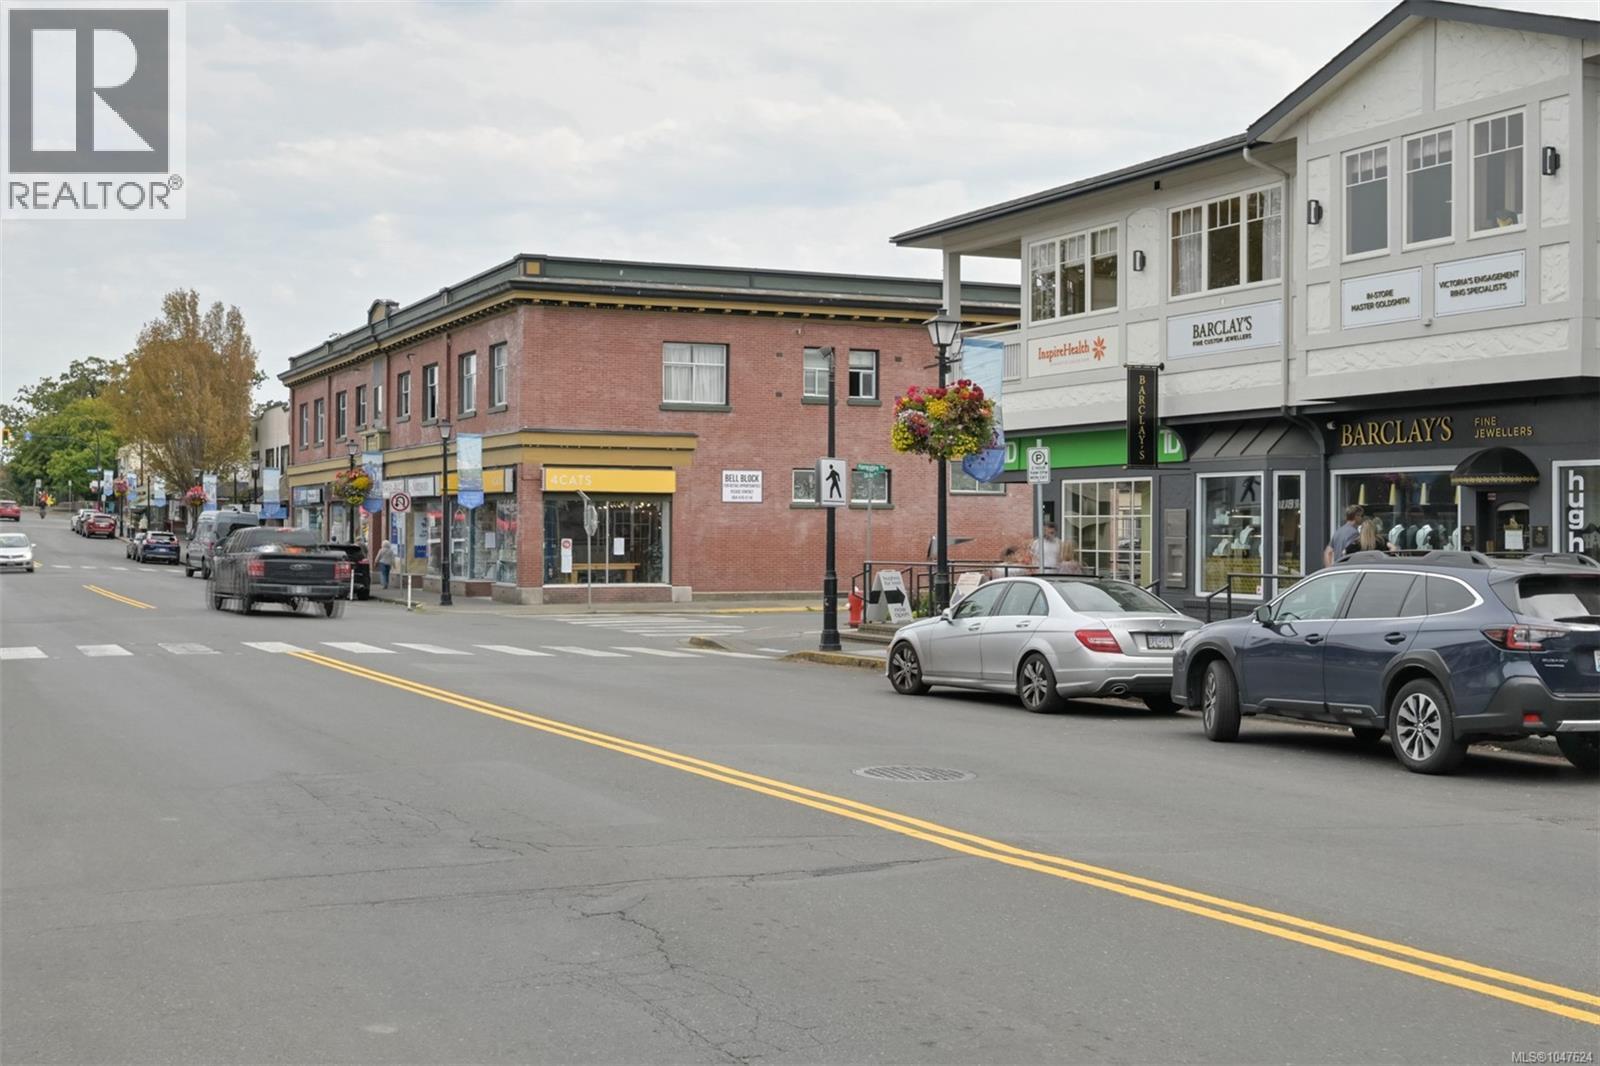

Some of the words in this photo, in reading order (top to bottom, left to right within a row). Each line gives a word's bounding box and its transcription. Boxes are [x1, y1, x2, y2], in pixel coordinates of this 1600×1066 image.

[1439, 277, 1473, 290] VICTORIA'S
[1474, 270, 1520, 285] ENGAGEMENT
[1366, 289, 1394, 301] IN-STORE
[1450, 289, 1466, 298] RING
[1467, 283, 1508, 296] SPECIALISTS
[1351, 302, 1375, 313] MASTER
[1376, 297, 1410, 310] GOLDSMITH
[1193, 316, 1253, 339] BARCLAY'S
[1225, 333, 1253, 343] JEWELLERS
[1038, 340, 1090, 363] InspireHealth
[1137, 375, 1147, 460] BARCLAY'S
[1474, 416, 1497, 429] FINE
[1341, 416, 1453, 447] BARCLAY'S
[1474, 426, 1533, 441] JEWELLERS
[550, 474, 593, 487] 4CATS
[725, 474, 739, 483] BELL
[740, 474, 760, 483] BLOCK
